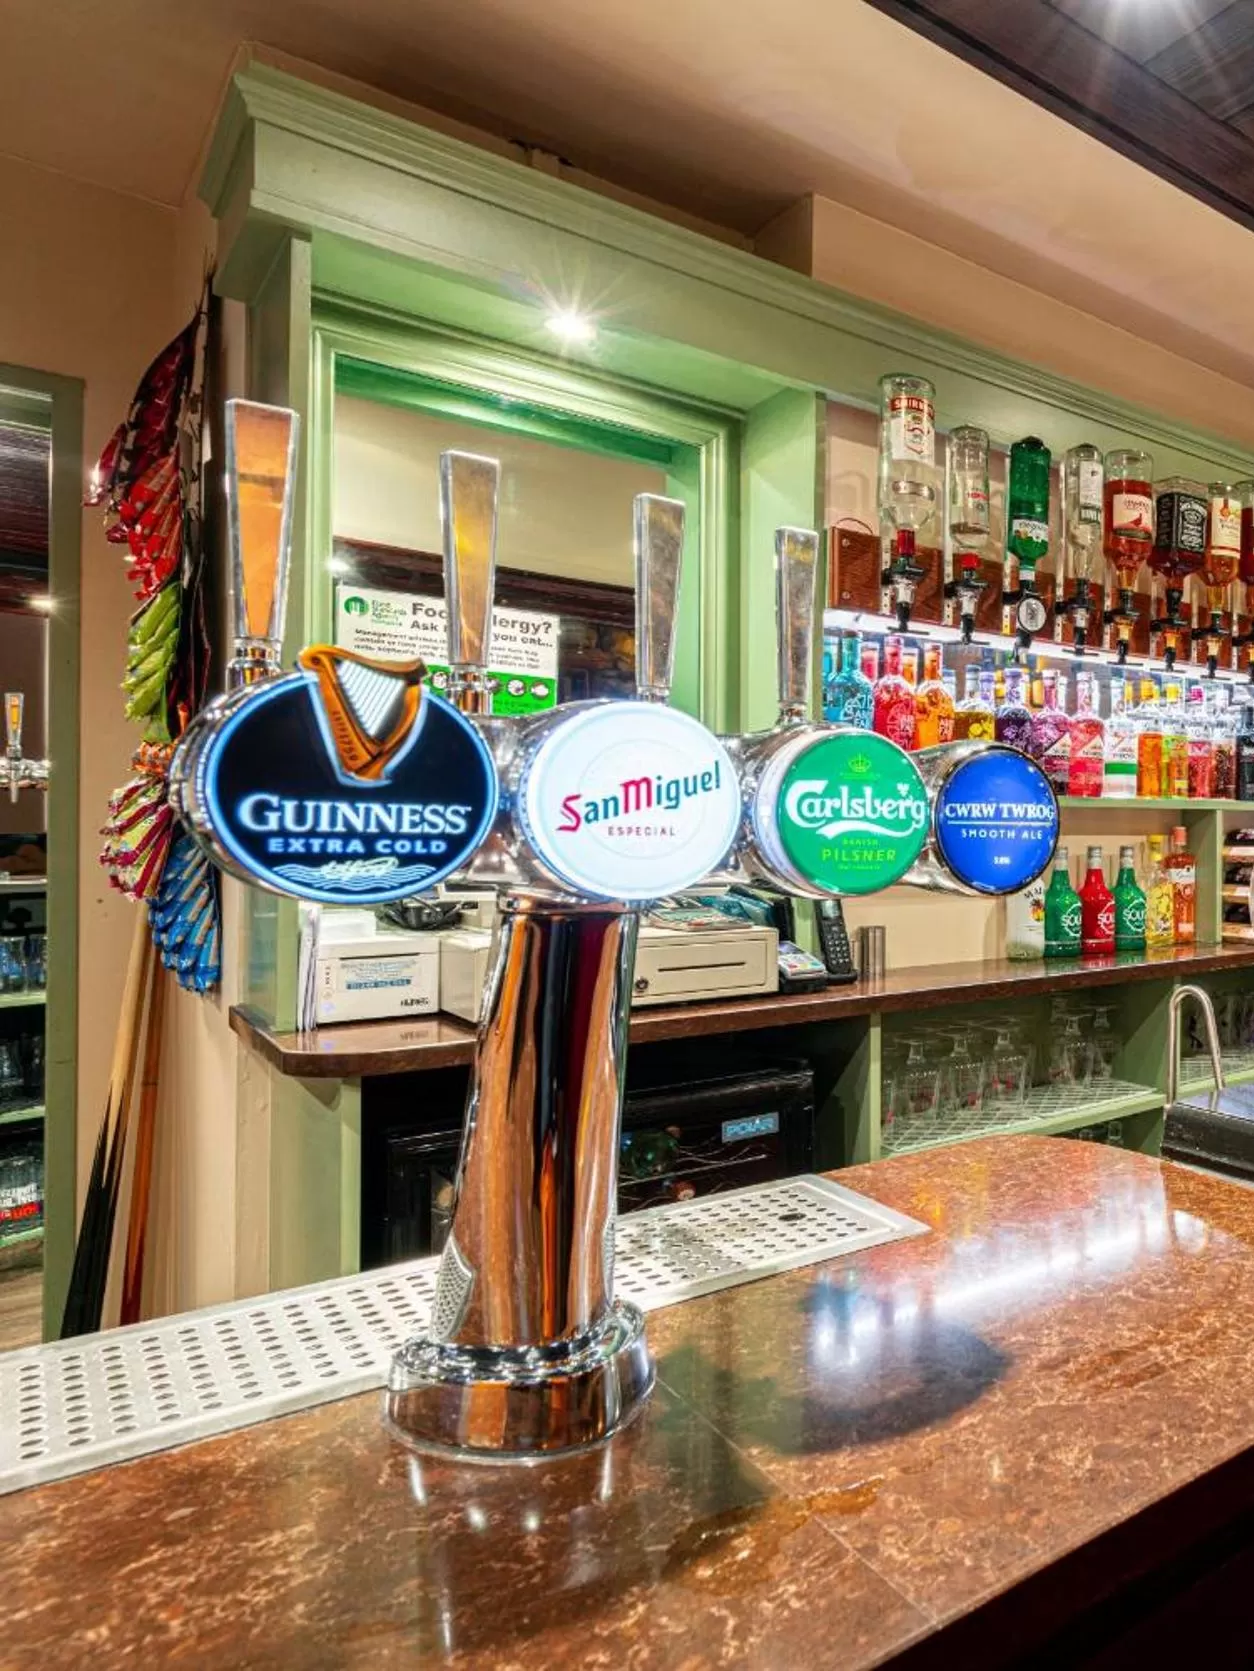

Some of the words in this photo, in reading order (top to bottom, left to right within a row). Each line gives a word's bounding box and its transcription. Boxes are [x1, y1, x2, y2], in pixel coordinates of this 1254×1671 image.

[412, 602, 449, 619] Foo
[493, 614, 552, 635] lergy?
[411, 616, 439, 631] Ask
[493, 633, 517, 641] you
[236, 792, 471, 834] GUINNESS
[785, 779, 926, 833] Carlsberg
[945, 803, 996, 818] CWRW
[1000, 803, 1055, 820] TWROG
[608, 826, 676, 836] ESPECIAL
[961, 829, 1015, 839] SMOOTH
[1021, 830, 1043, 840] ALE
[267, 838, 365, 853] EXTRA
[375, 839, 447, 854] COLD
[822, 848, 896, 861] PILSNER
[1061, 913, 1082, 927] SOU
